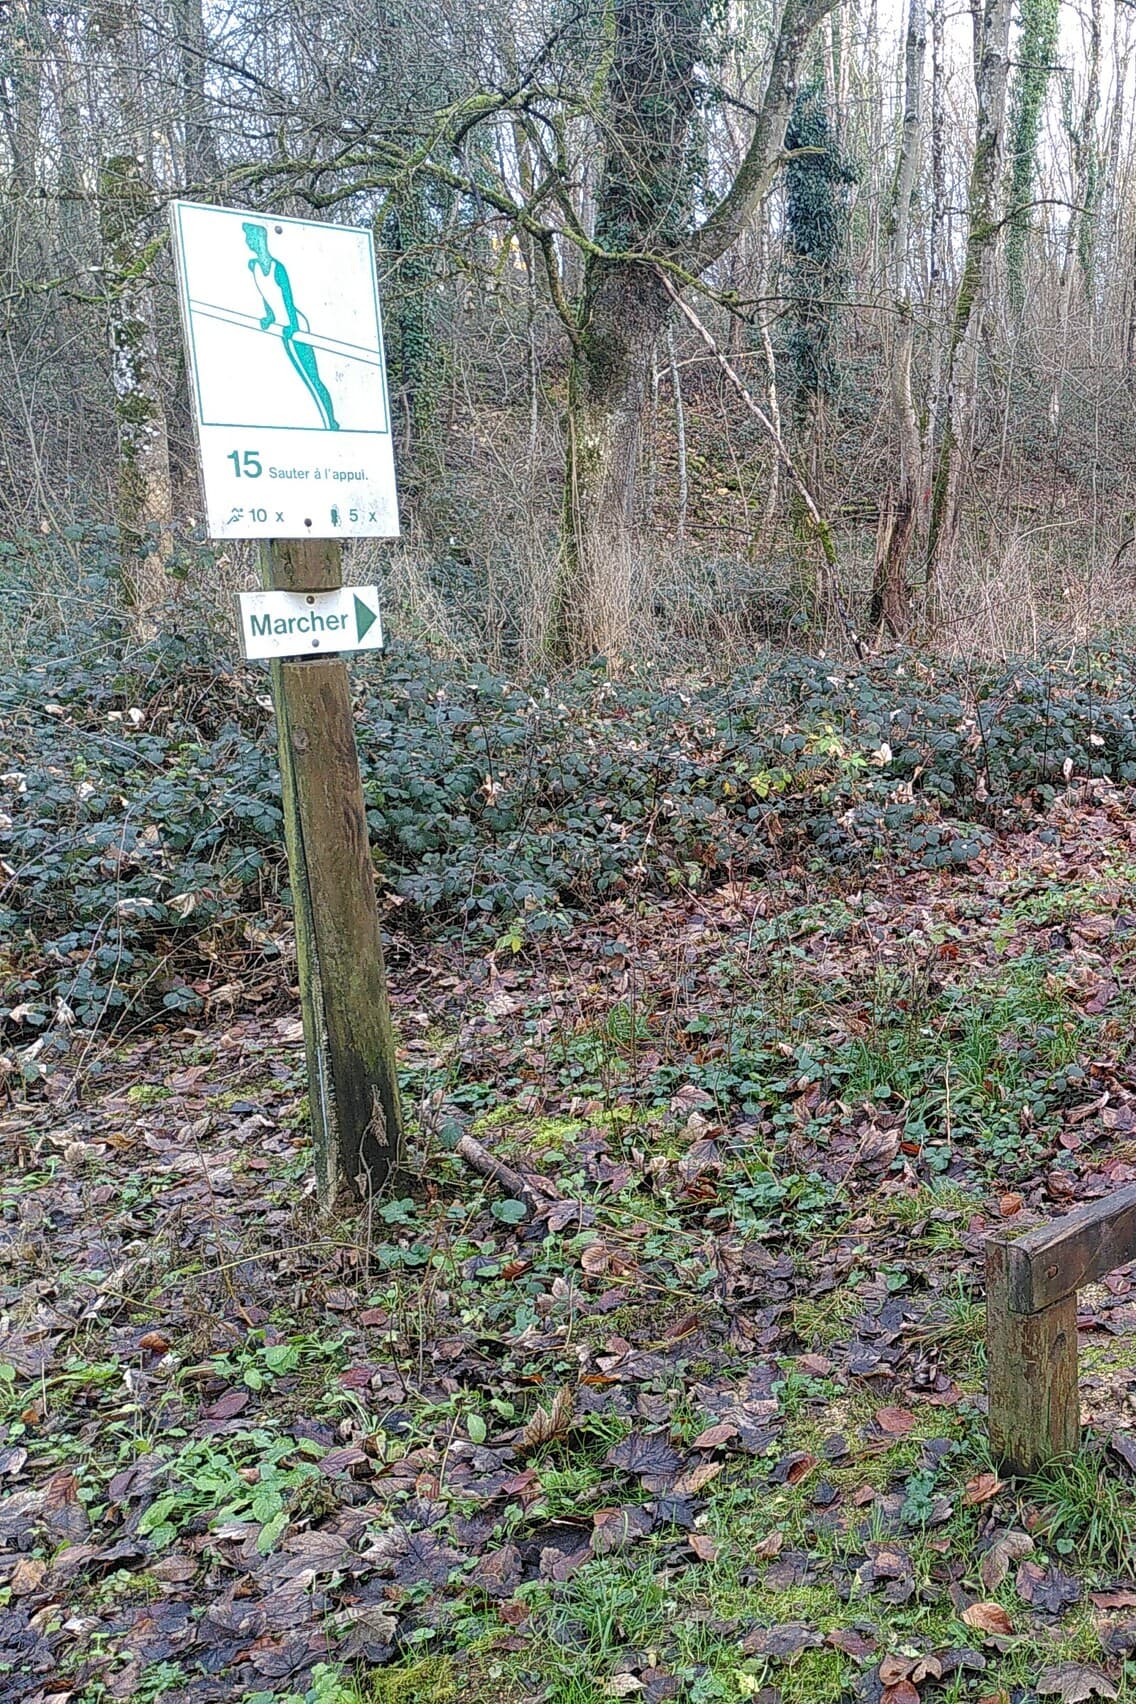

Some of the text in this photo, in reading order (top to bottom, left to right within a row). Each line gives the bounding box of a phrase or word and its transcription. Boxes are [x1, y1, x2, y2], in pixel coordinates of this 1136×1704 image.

[227, 450, 263, 479] 15
[268, 466, 310, 480] Sauter
[249, 508, 267, 523] 10
[349, 508, 358, 522] 5
[250, 610, 349, 636] Marcher
